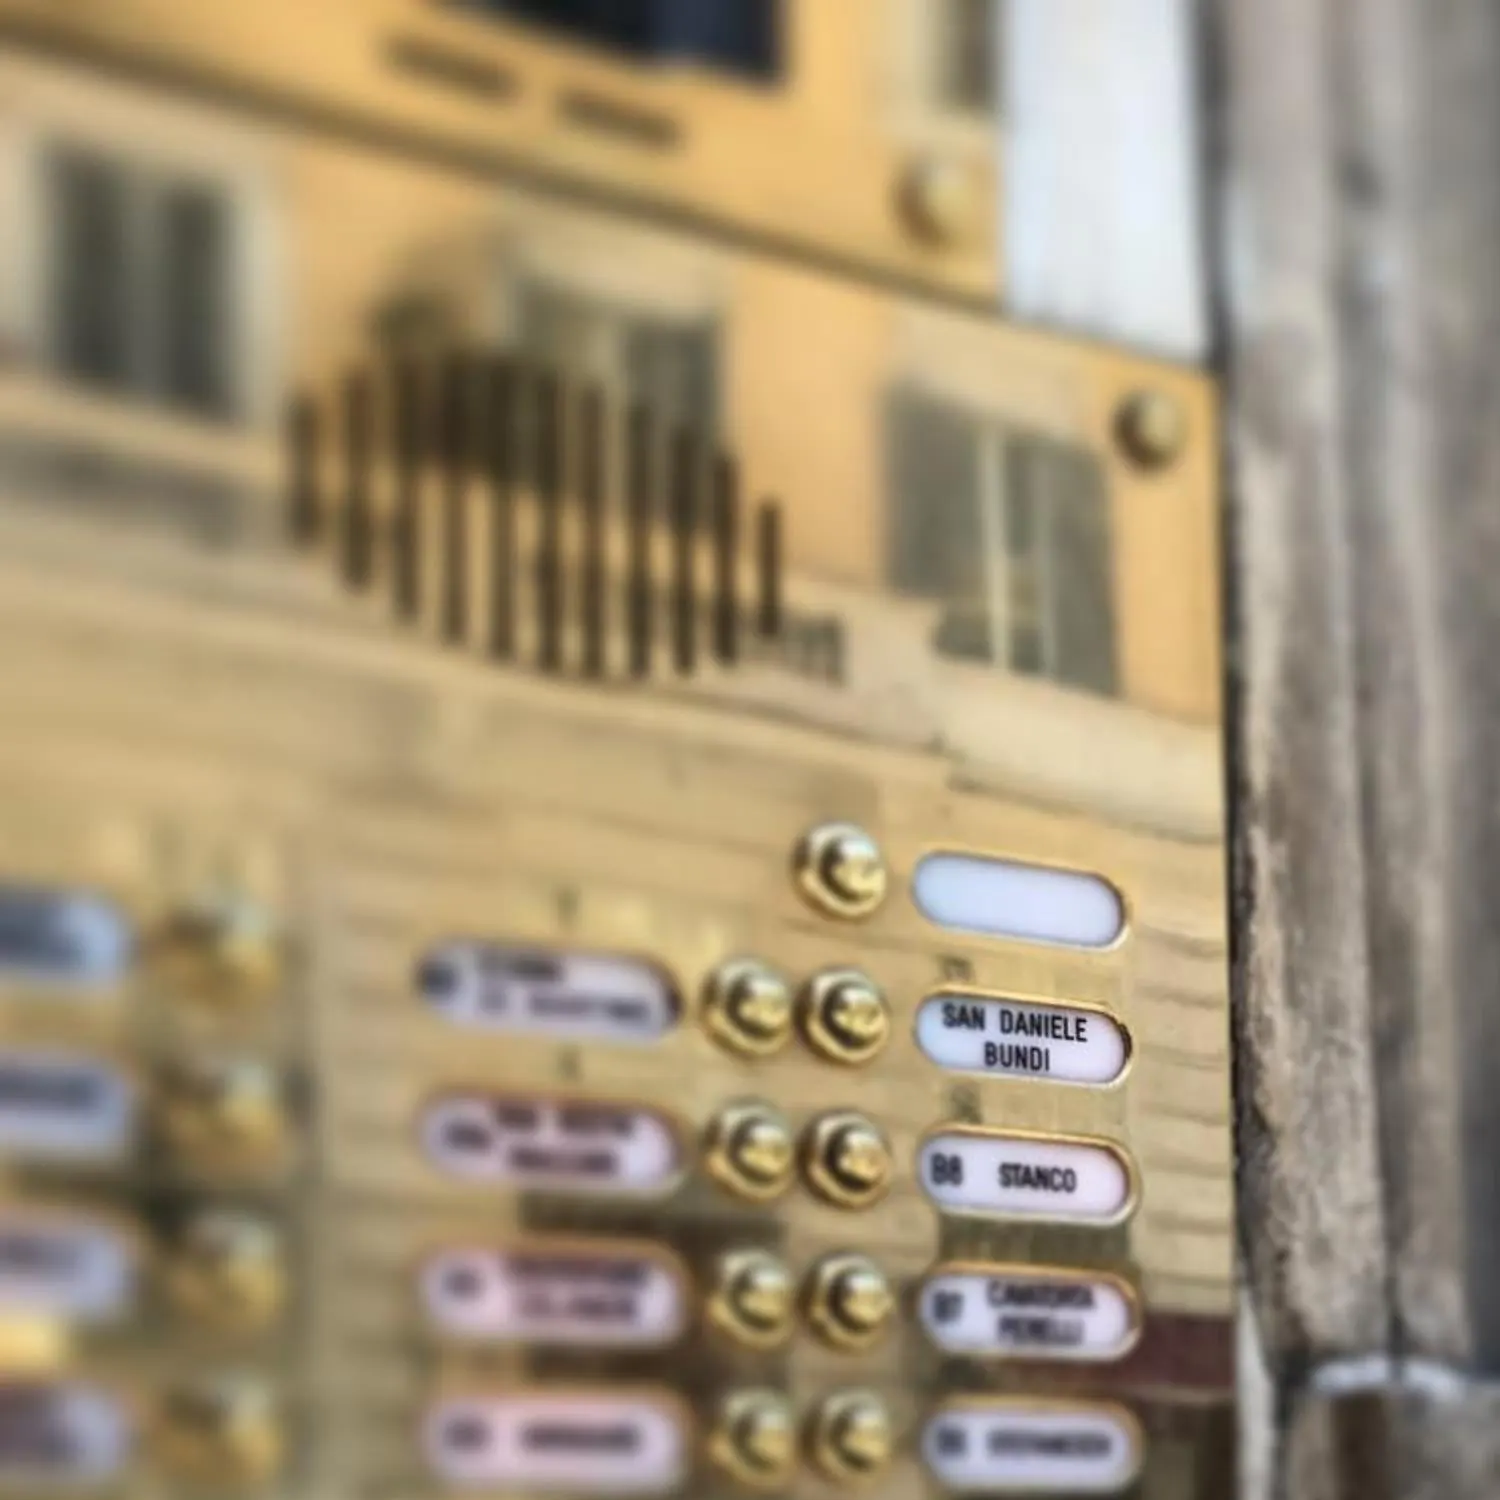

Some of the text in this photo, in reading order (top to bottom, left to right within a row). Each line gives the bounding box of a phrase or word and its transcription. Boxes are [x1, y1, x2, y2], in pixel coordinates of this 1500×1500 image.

[941, 1003, 1088, 1042] SAN DANIELE
[984, 1041, 1050, 1071] BUNDI
[999, 1162, 1077, 1193] STANCO
